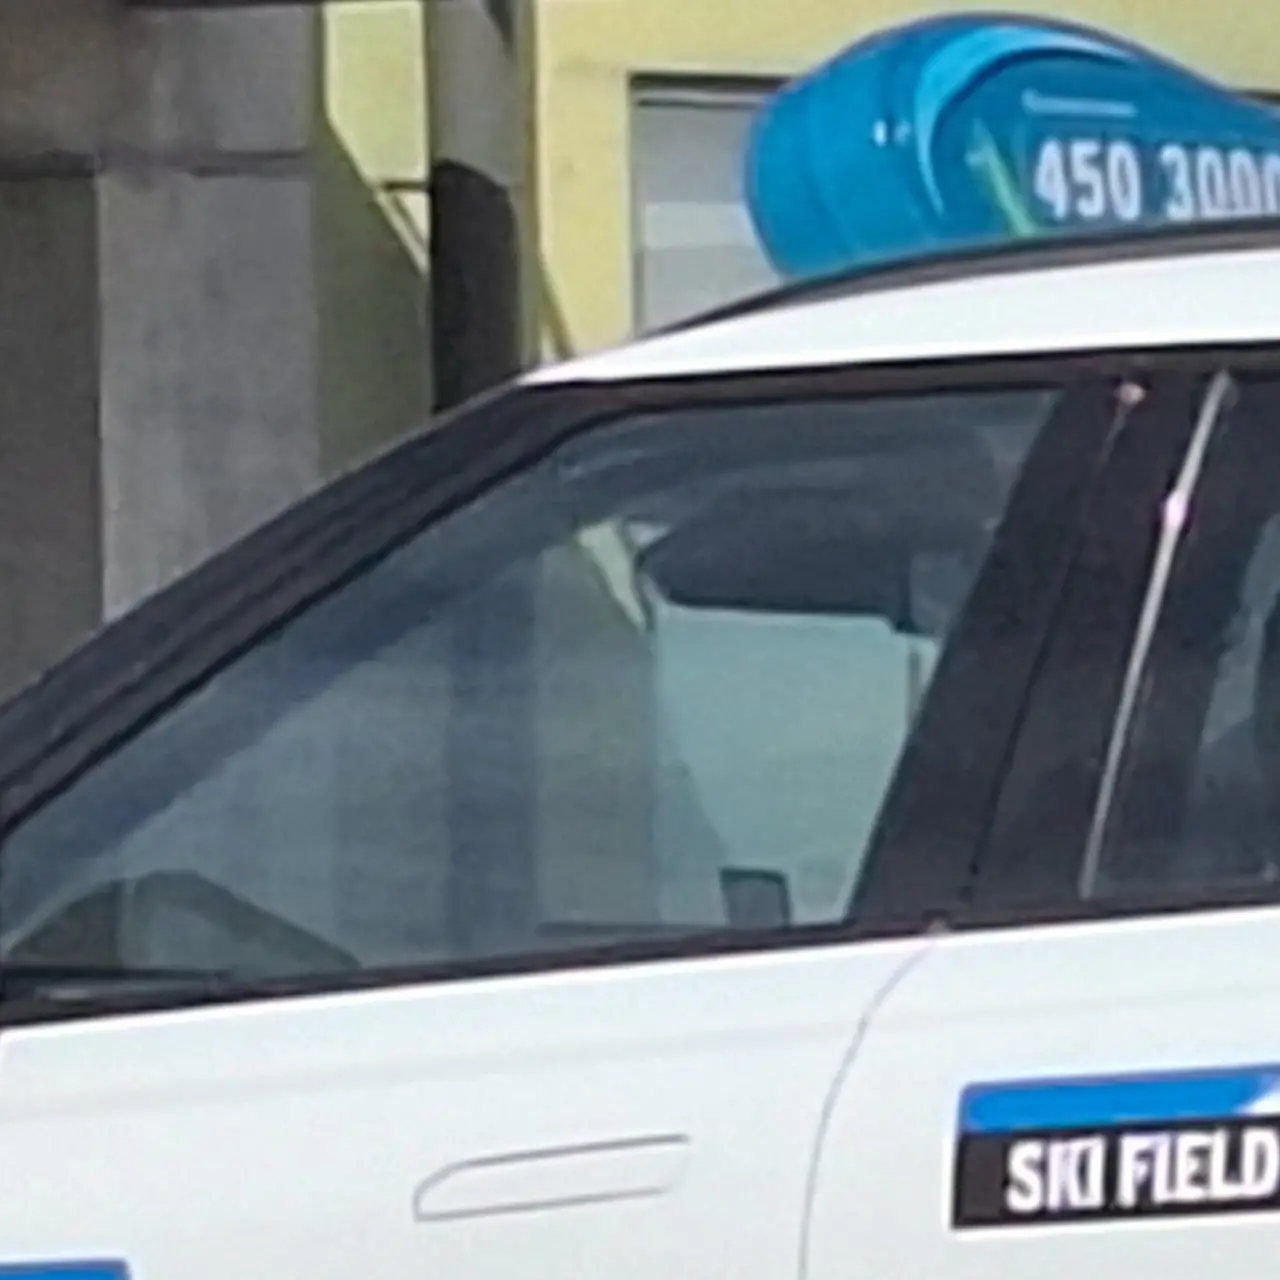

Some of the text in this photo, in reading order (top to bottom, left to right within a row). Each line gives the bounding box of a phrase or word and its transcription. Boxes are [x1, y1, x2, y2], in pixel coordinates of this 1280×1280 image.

[1037, 139, 1140, 218] 450
[1005, 1138, 1105, 1211] SKI
[1122, 1124, 1279, 1206] FIELD
